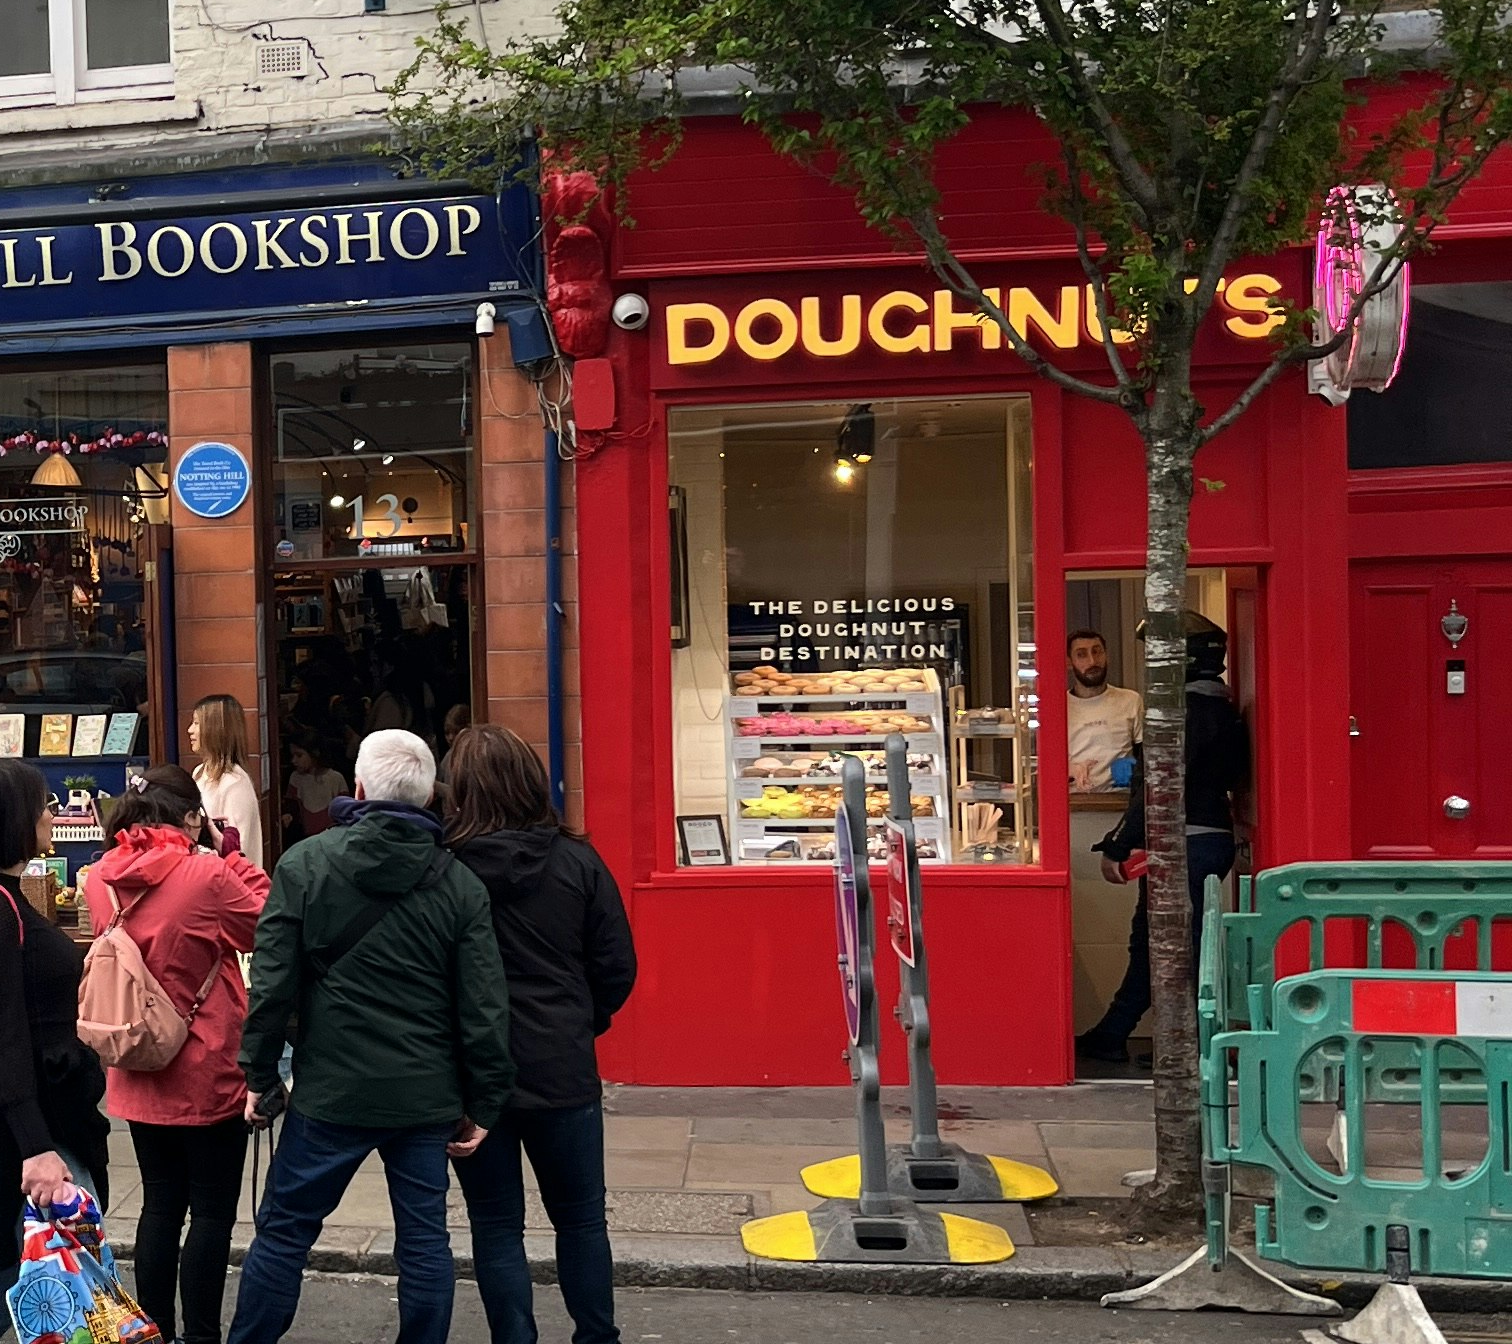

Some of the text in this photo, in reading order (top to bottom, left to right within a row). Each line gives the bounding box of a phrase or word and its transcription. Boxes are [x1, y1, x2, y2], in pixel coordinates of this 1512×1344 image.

[95, 204, 482, 284] BOOKSHOP
[179, 471, 245, 482] NOTTING HILL
[345, 493, 402, 540] 13
[749, 597, 956, 616] THE DELICIOUS
[779, 621, 926, 639] DOUGHNUT
[760, 644, 947, 662] DESTINATION
